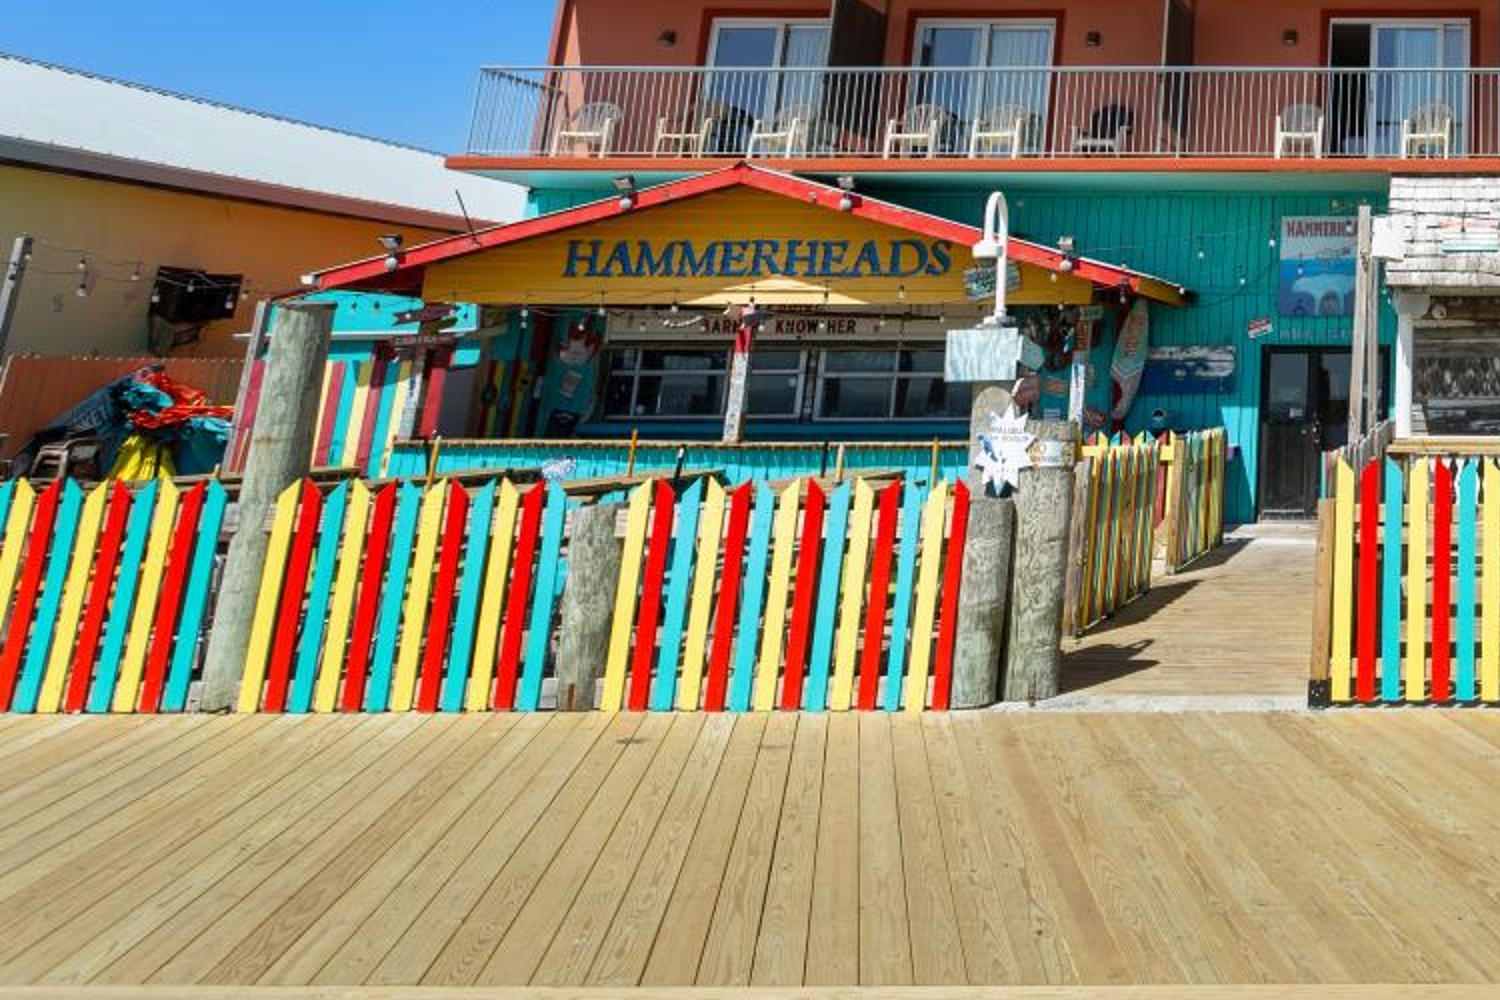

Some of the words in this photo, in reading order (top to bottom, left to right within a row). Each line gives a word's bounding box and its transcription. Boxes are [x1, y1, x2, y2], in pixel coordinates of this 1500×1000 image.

[562, 239, 952, 278] HAMMERHEADS
[775, 319, 818, 335] KNOW
[827, 319, 856, 334] HER
